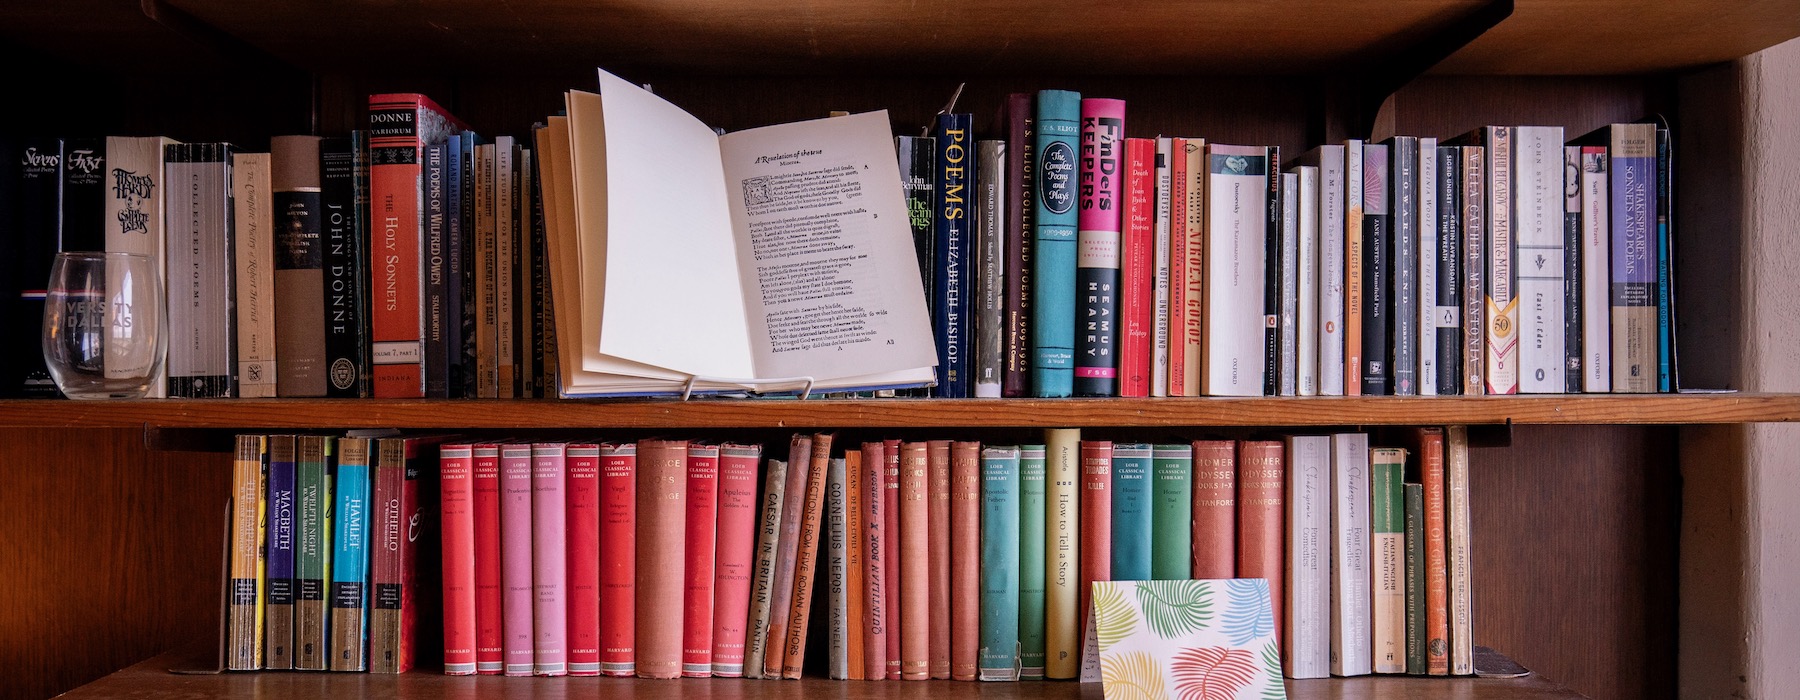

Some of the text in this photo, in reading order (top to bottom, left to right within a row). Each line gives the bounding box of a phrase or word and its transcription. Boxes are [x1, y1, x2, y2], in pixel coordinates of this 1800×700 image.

[371, 112, 412, 123] DONNE
[754, 156, 761, 165] A
[1044, 161, 1072, 172] Complete
[1051, 150, 1065, 160] The
[1082, 117, 1095, 211] KEEPERS
[1098, 117, 1122, 211] FinDers
[1133, 169, 1148, 177] Death
[1048, 170, 1068, 180] Poems
[430, 147, 443, 285] THE POEMS OF WILFRED OWEN
[1048, 190, 1069, 205] Plays
[1161, 176, 1169, 219] DOSTOEVSKY
[1469, 153, 1479, 260] WILLA CATHER
[386, 217, 398, 250] HOLY
[1022, 191, 1030, 262] COLLECTED
[1131, 214, 1147, 223] Other
[1131, 223, 1150, 231] Stories
[1625, 165, 1635, 274] SONNETS AND POEMS
[944, 128, 965, 363] POEMS ELIZABETH BISHOP
[328, 204, 345, 334] JOHN DONNE
[386, 255, 399, 311] SONNETS
[1351, 272, 1358, 280] OF
[1021, 269, 1029, 308] POEMS
[66, 302, 132, 314] VERSTY
[1088, 282, 1098, 357] HEANEY
[1100, 284, 1110, 356] SEAMUS
[1494, 319, 1508, 331] 50
[1430, 455, 1440, 481] THE
[806, 466, 821, 521] SELECTIONS
[1060, 494, 1069, 518] How
[1430, 484, 1440, 521] SPIRIT
[280, 490, 290, 550] MACBETH
[350, 499, 360, 549] HAMLET
[390, 499, 399, 551] OTHELLO
[803, 523, 814, 549] FROM
[831, 482, 842, 594] CORNELIUS NEPOS
[1060, 520, 1068, 530] to
[1310, 527, 1318, 546] Four
[1430, 527, 1440, 544] OF
[756, 493, 778, 603] CAESAR IN BRITAIN
[1060, 532, 1068, 550] Tell
[1302, 528, 1310, 567] Comedies
[1346, 528, 1354, 568] Tragedies
[1354, 527, 1362, 571] Four Great
[1409, 555, 1414, 564] OF
[800, 552, 809, 571] FIVE
[871, 522, 881, 635] QUINTILIAN BOOK X
[1057, 561, 1069, 587] Story
[795, 575, 806, 608] ROMAN
[752, 619, 763, 653] PANTIN
[790, 610, 802, 656] AUTHORS
[833, 607, 841, 650] FARNELL
